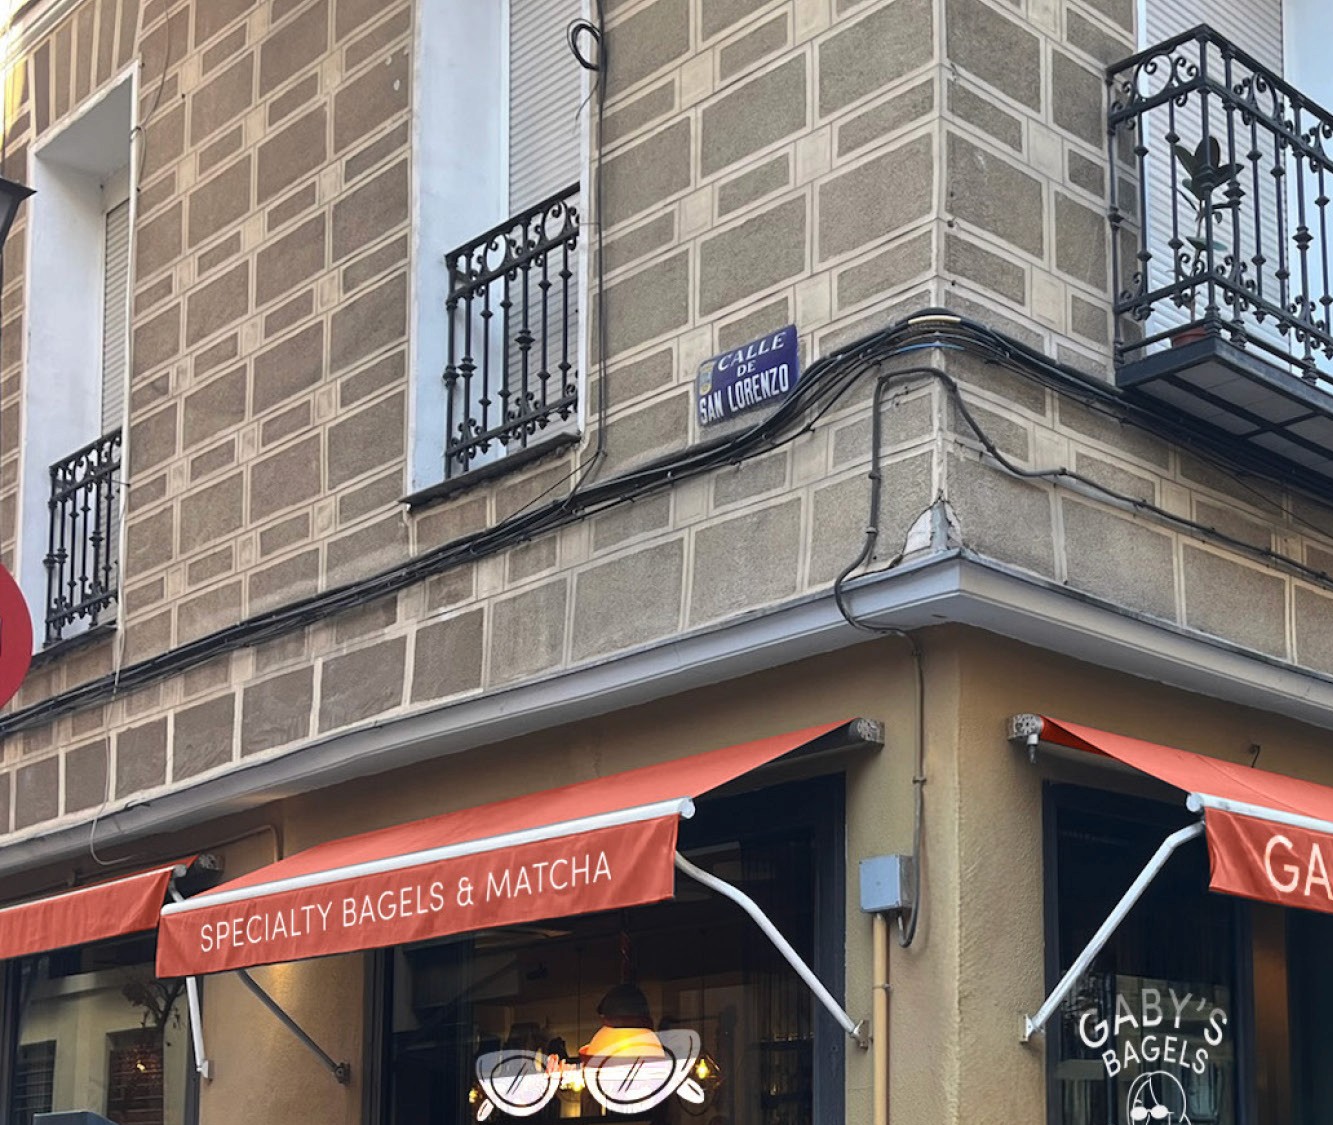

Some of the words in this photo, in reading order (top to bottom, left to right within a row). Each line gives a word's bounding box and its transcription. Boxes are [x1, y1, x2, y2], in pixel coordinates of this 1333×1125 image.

[717, 332, 786, 371] CALLE
[736, 359, 757, 377] DE
[699, 390, 725, 424] SAN
[727, 363, 790, 413] LORENZO
[200, 901, 334, 954] SPECIALTY
[342, 880, 445, 929] BAGELS
[457, 876, 474, 907] &
[486, 850, 612, 901] MATCHA
[1079, 988, 1228, 1048] GABY'S
[1101, 1035, 1209, 1078] BAGELS
